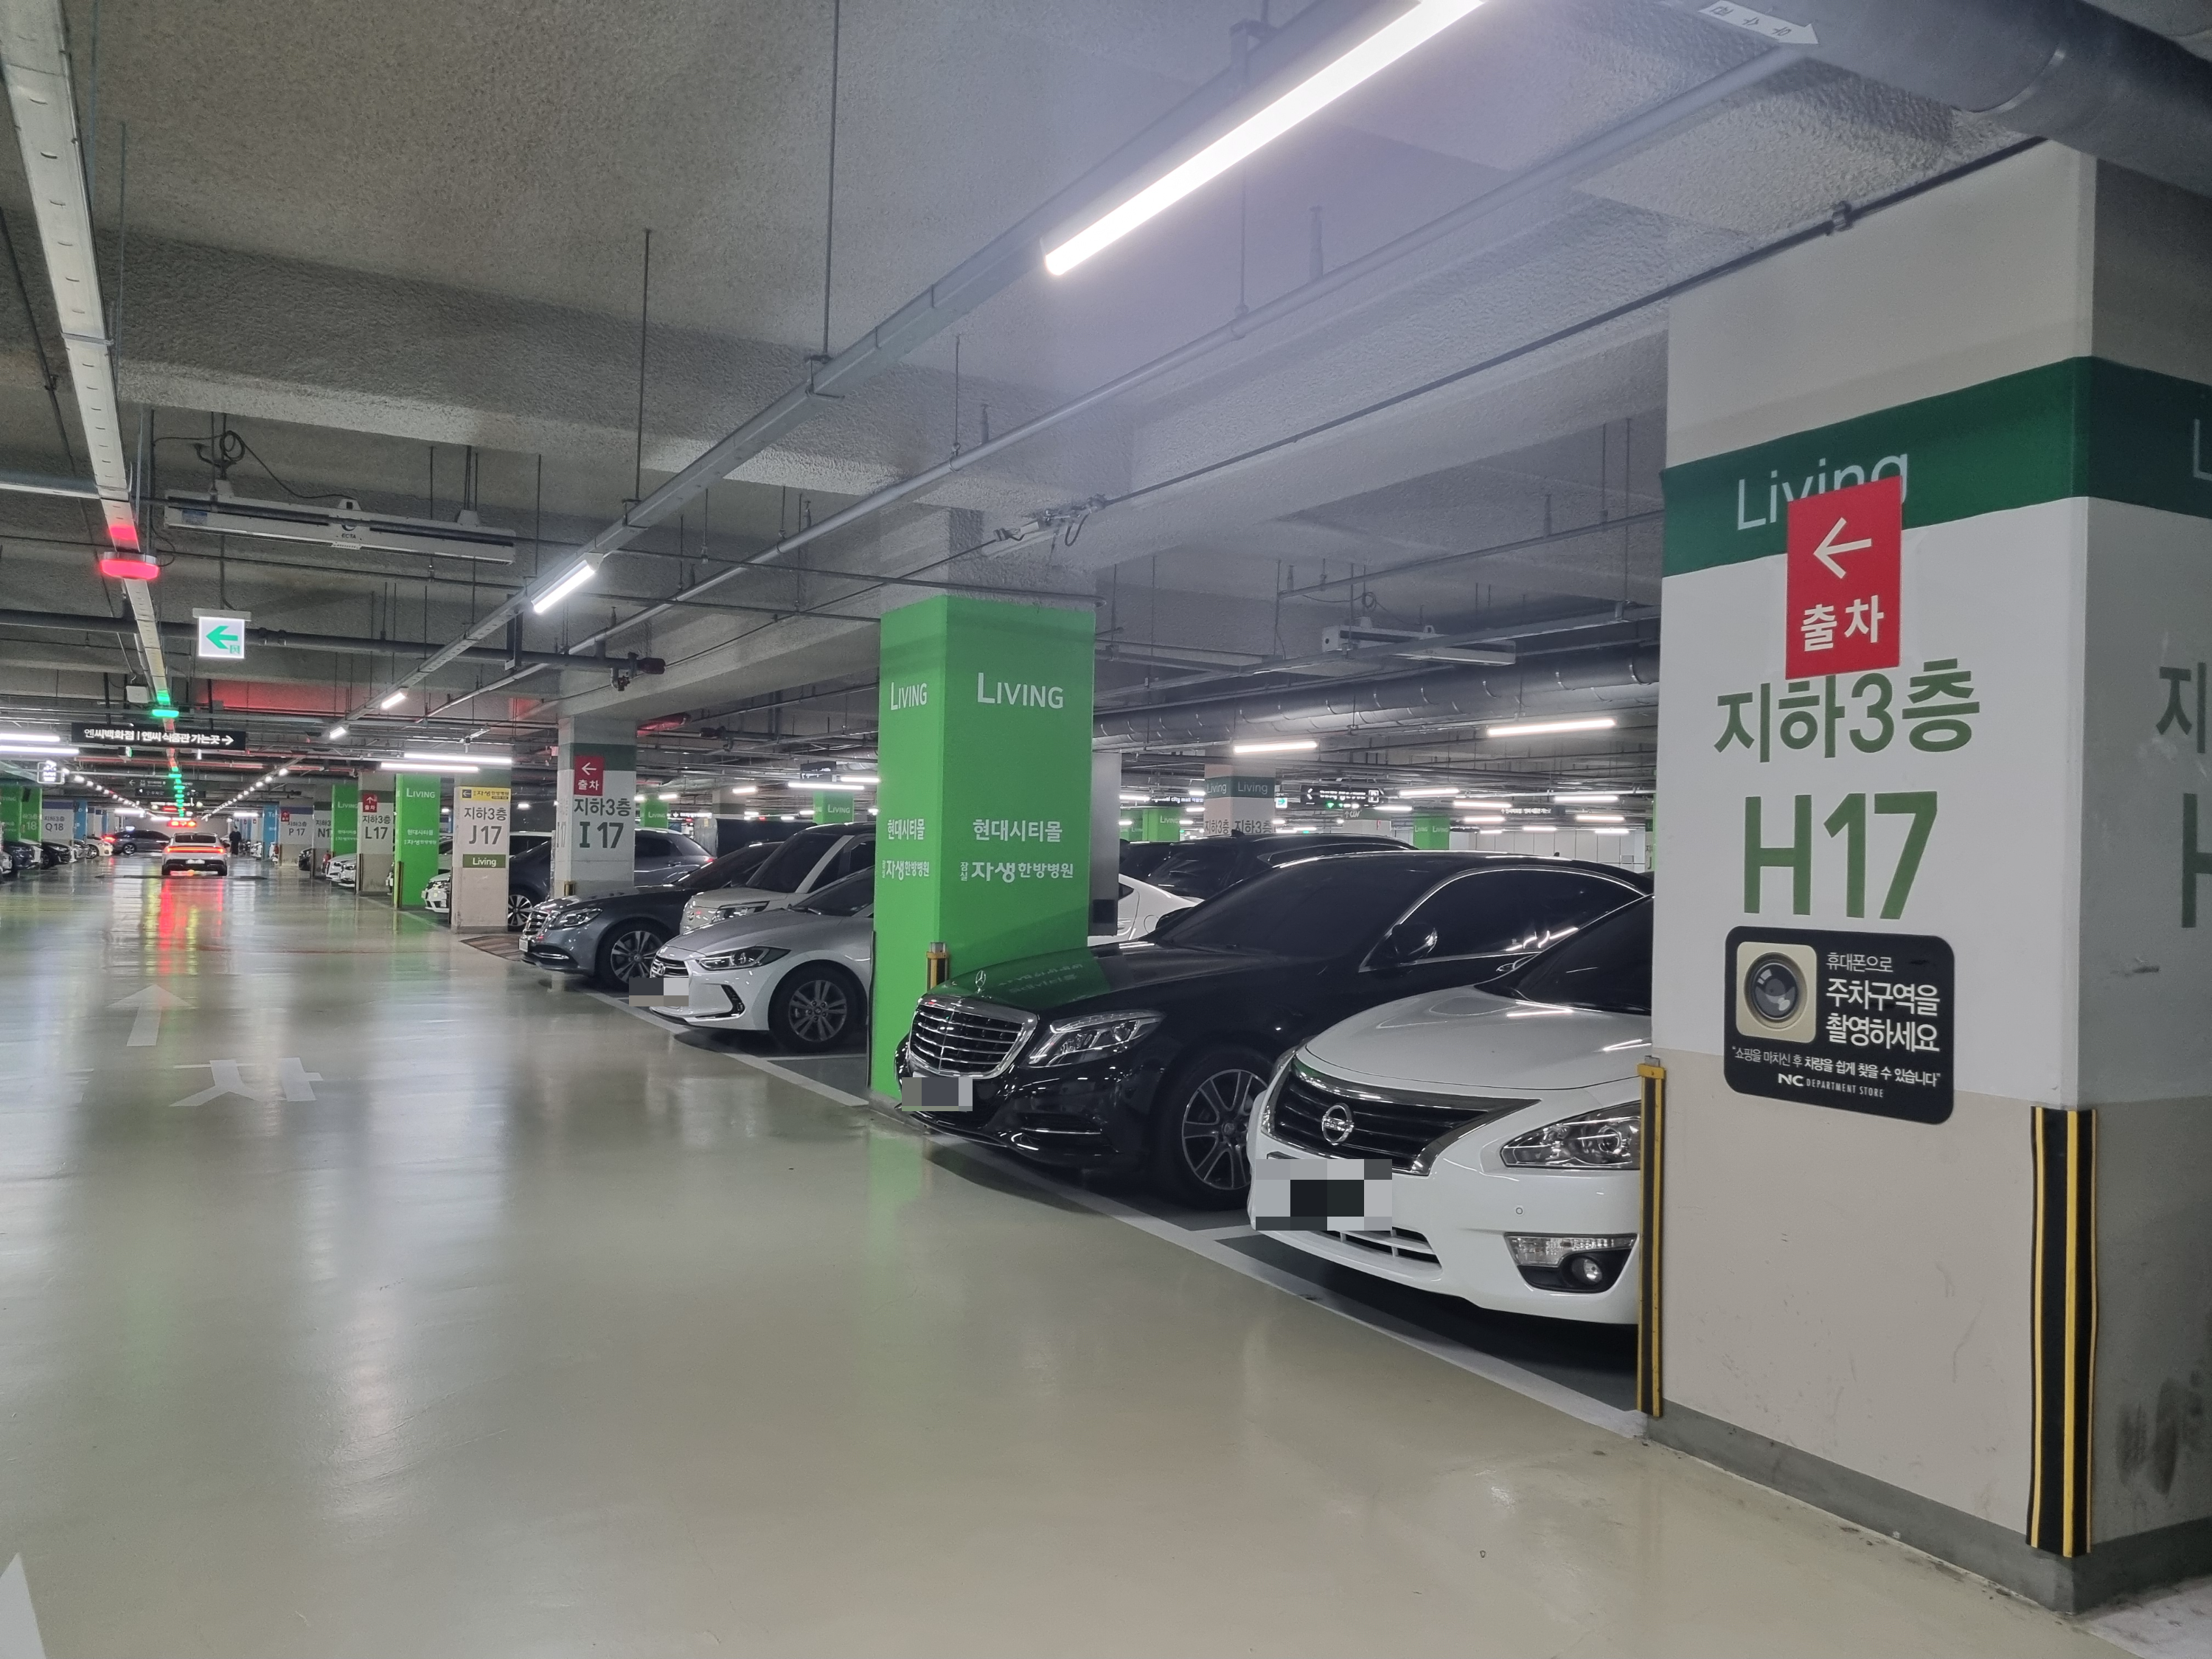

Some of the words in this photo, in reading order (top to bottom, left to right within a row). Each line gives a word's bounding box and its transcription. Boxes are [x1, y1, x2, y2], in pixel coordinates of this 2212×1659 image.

[1801, 594, 1885, 652] 출차
[1714, 658, 1980, 762] 지하3층
[84, 728, 135, 741] 엔씨백화점
[577, 779, 599, 790] 출차
[1207, 783, 1227, 795] Living
[1238, 782, 1268, 795] Living
[464, 807, 507, 821] 지하3층
[574, 798, 632, 817] 지하3층
[362, 815, 392, 824] 지하3층
[887, 818, 925, 841] 현대시티몰
[973, 818, 1062, 843] 현대시티몰
[1205, 818, 1229, 835] 지하3층
[472, 857, 497, 868] Living
[1743, 790, 1938, 920] H17
[1826, 951, 1893, 973] 휴대폰으로
[1826, 978, 1941, 1017] 주차구역을
[1826, 1012, 1941, 1052] 촬영하세요
[1763, 1050, 1791, 1067] 마치신
[1792, 1054, 1804, 1068] 후
[1804, 1056, 1834, 1073] 차량을
[1835, 1060, 1856, 1077] 쉽게
[1857, 1062, 1879, 1079] 찾을
[1880, 1066, 1892, 1081] 수
[1778, 1073, 1804, 1087] NC
[1806, 1079, 1857, 1094] DEPARTMENT
[1859, 1085, 1885, 1098] STORE
